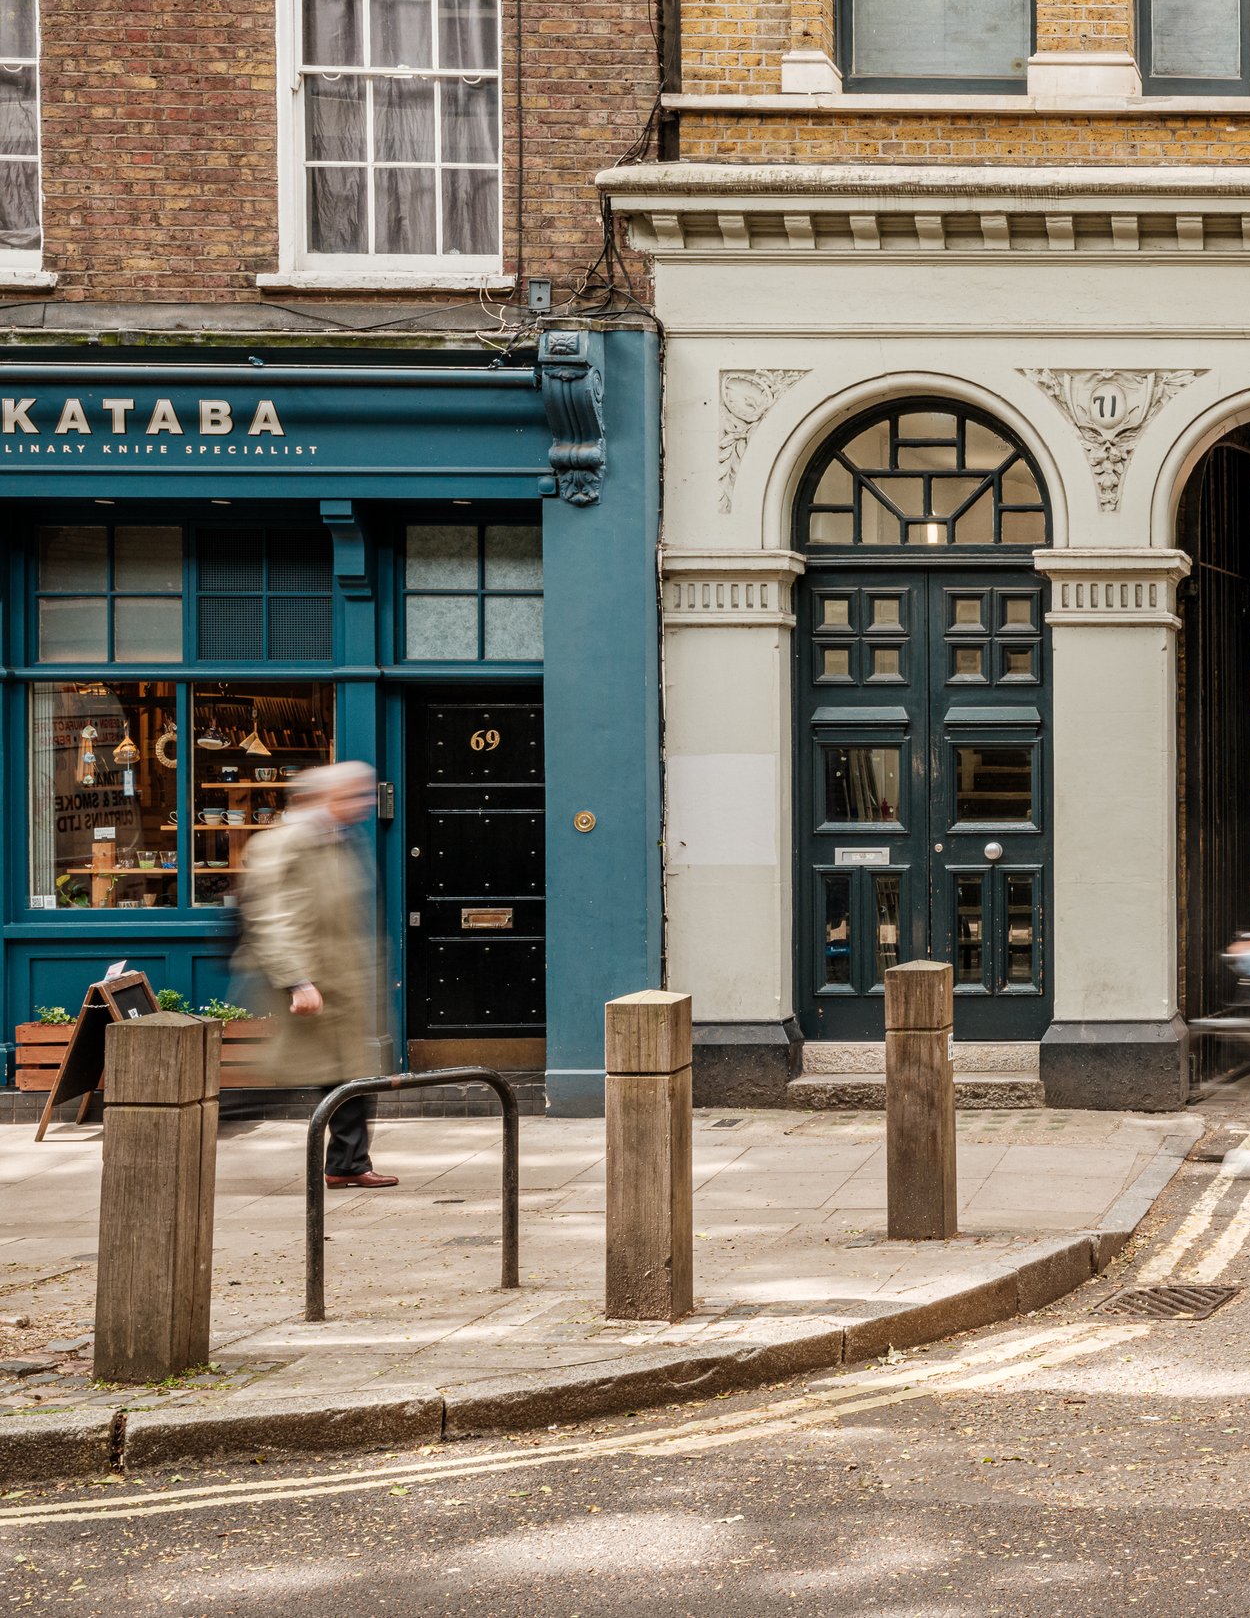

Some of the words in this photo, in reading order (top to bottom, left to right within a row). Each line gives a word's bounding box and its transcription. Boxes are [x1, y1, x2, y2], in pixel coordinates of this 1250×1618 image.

[2, 398, 286, 436] KATABA
[1093, 395, 1117, 418] 71
[4, 444, 86, 453] LINARY
[103, 445, 168, 454] KNIFE
[185, 445, 318, 455] SPECIALIST
[470, 729, 500, 751] 69
